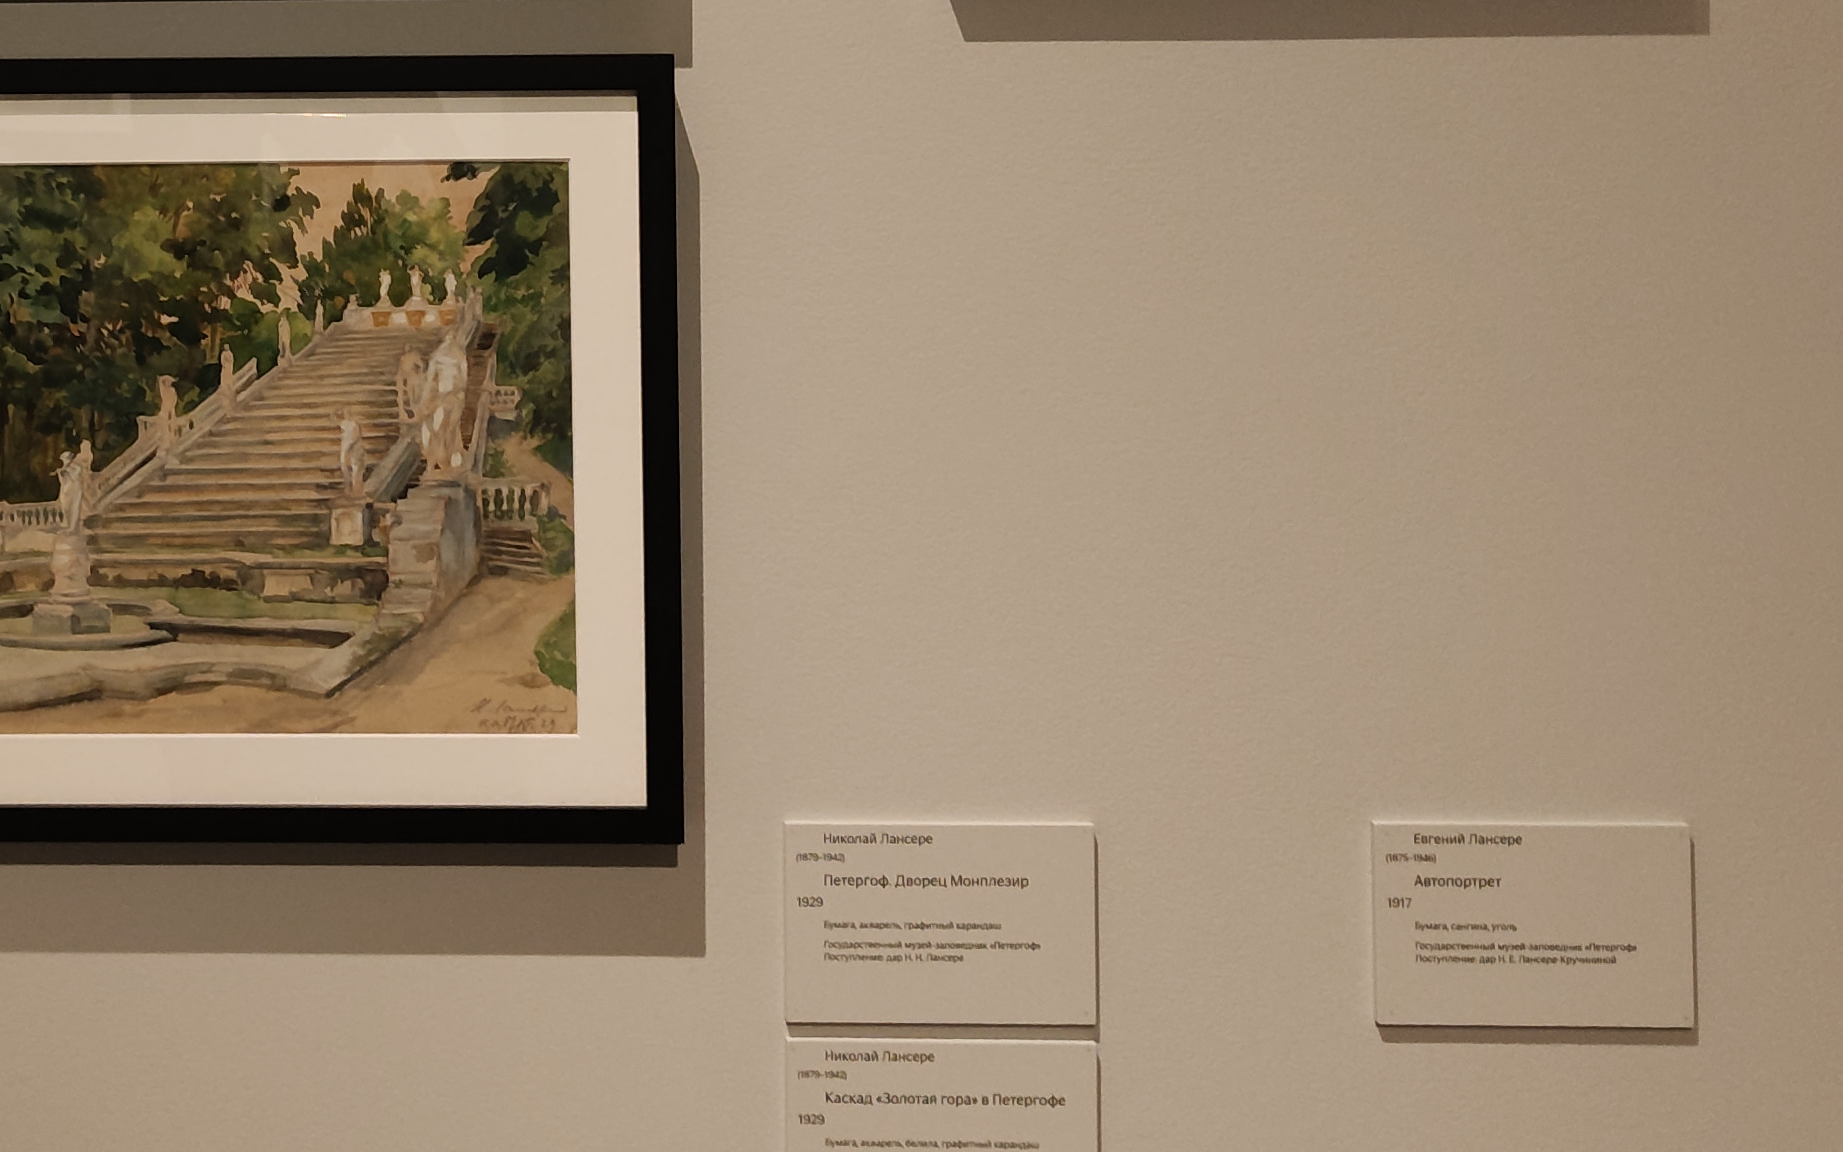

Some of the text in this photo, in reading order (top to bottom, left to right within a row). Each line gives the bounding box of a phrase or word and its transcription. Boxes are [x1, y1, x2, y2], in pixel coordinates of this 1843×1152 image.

[823, 833, 933, 846] Николай Лансере
[1413, 833, 1523, 847] Евгений Лансере
[823, 874, 1030, 889] Петергоф. Дворец Монплезир
[1413, 875, 1502, 889] Автопортрет
[796, 896, 824, 907] 1929
[1387, 897, 1413, 908] 1917
[823, 920, 857, 930] Бумага,
[955, 923, 1001, 931] карандаш
[1414, 921, 1449, 932] Бумага,
[1491, 924, 1517, 932] уголь
[1415, 941, 1495, 952] Государственный
[1479, 956, 1496, 964] дар
[824, 1050, 935, 1064] Николай Лансере
[824, 1092, 873, 1105] Каскад
[876, 1092, 937, 1104] «Золотая
[941, 1095, 979, 1107] гора»
[992, 1094, 1067, 1108] Петергофе
[798, 1114, 826, 1125] 1929
